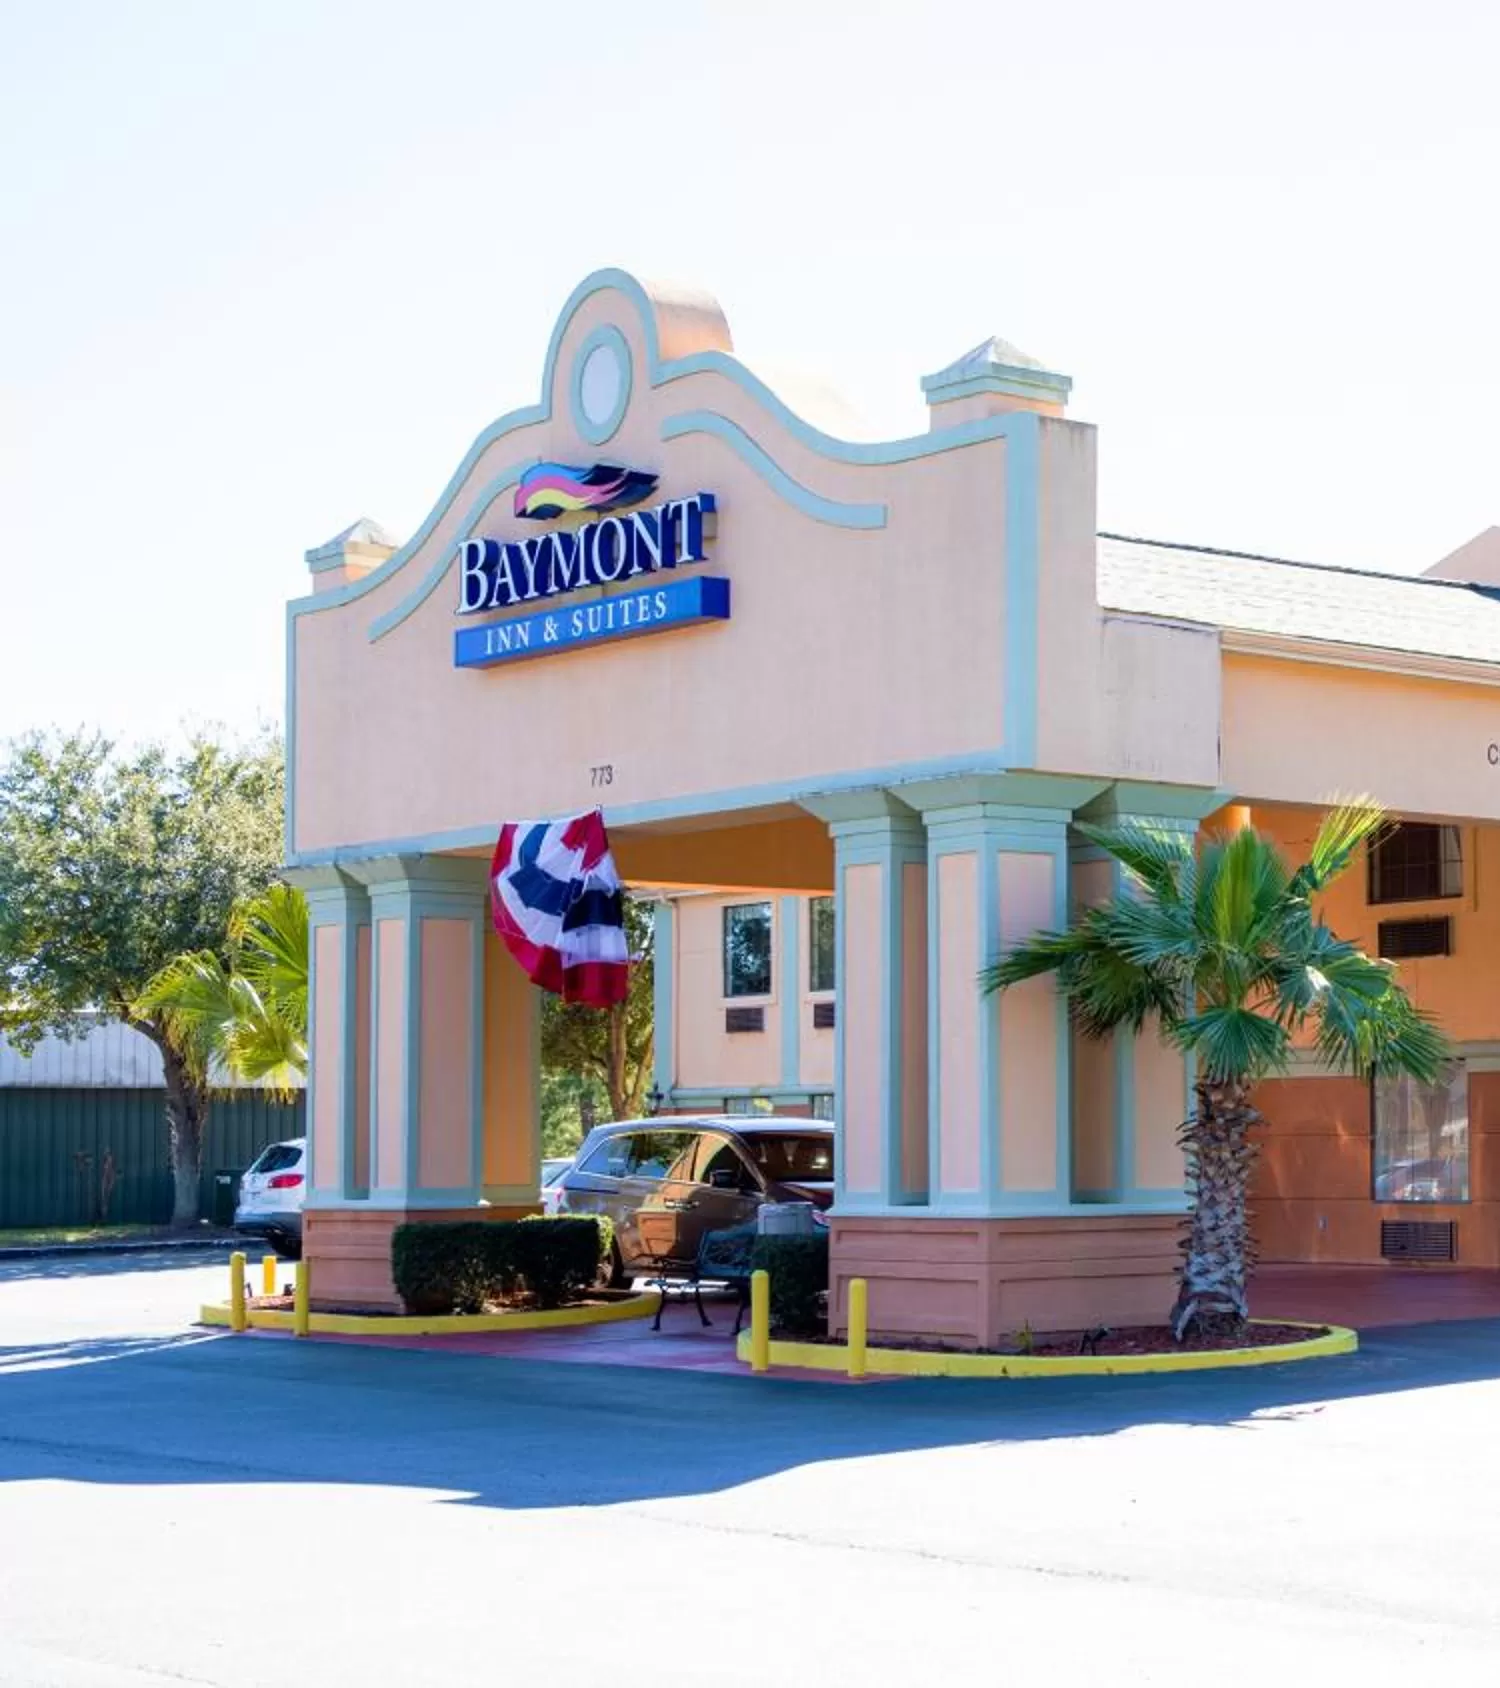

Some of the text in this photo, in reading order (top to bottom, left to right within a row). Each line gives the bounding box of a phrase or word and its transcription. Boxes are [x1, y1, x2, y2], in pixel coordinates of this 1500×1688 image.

[455, 495, 703, 615] BAYMONT
[484, 591, 668, 655] INN & SUITES
[590, 764, 613, 788] 773
